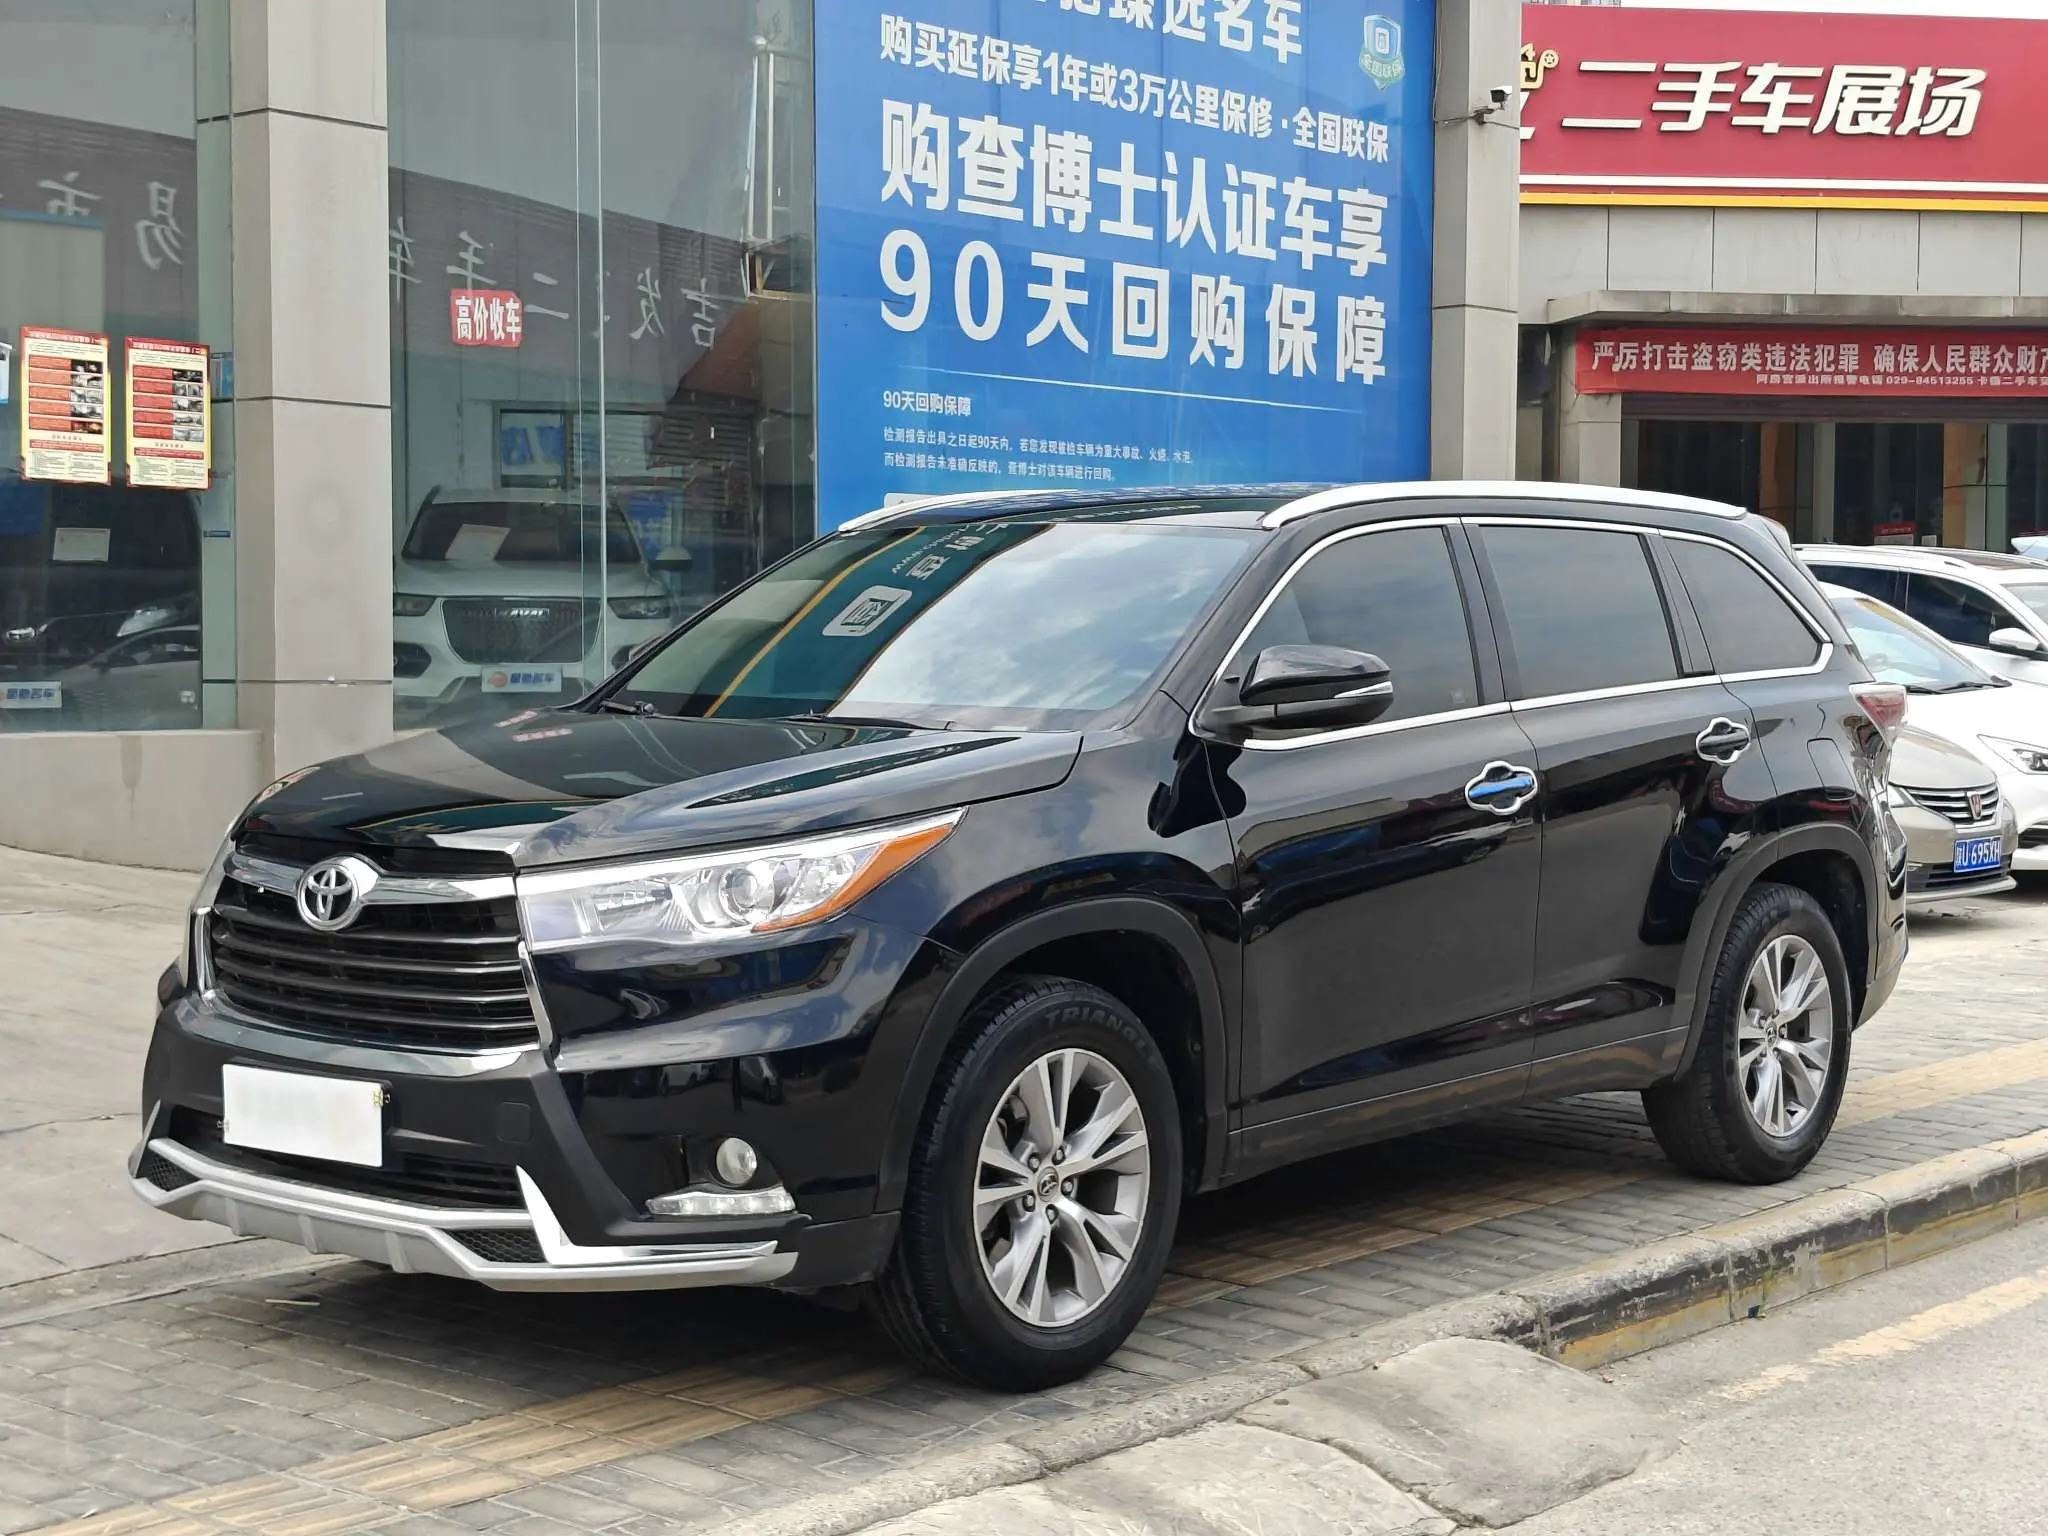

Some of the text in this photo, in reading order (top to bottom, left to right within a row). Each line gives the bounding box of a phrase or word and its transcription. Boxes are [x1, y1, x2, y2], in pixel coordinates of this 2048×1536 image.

[1561, 61, 1988, 137] 二手车展场
[881, 98, 1389, 279] 购查博士认证车享
[455, 295, 522, 342] 高价收车
[879, 228, 1388, 386] 90天回购保障
[1591, 340, 1859, 373] 严厉打击盗窃类违法犯罪
[882, 390, 973, 417] 90天回购保障
